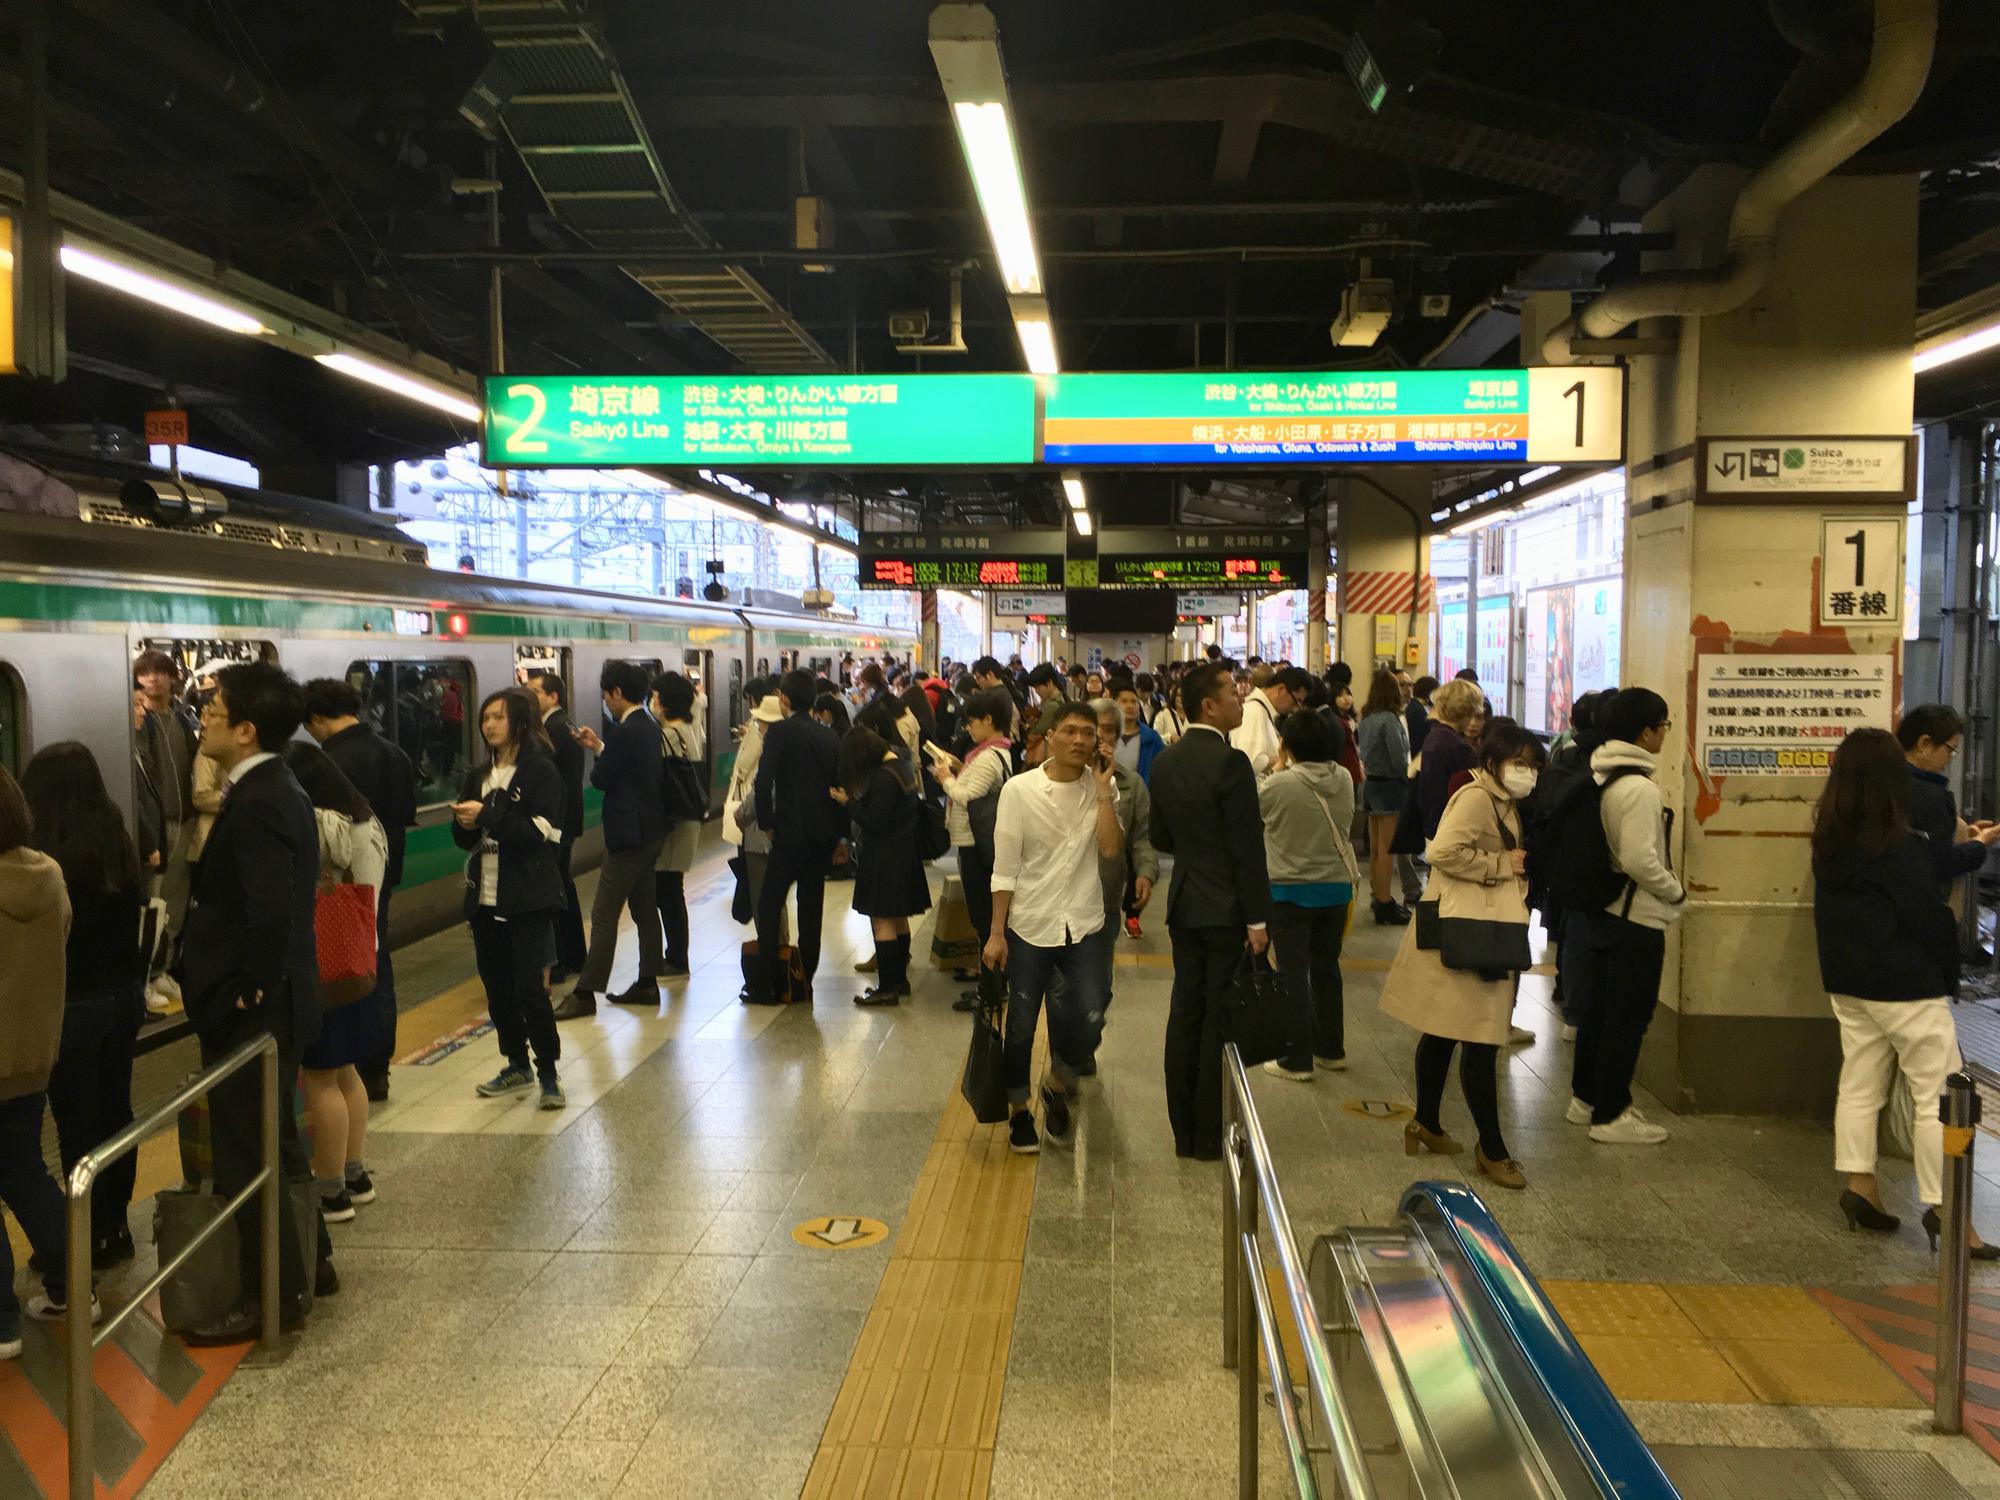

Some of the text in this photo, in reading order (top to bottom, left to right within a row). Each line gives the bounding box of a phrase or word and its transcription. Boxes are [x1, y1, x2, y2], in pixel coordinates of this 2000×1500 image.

[569, 385, 661, 416] 埼京線
[1377, 400, 1397, 410] Line
[1497, 399, 1518, 409] Line
[825, 405, 849, 416] Line
[1563, 381, 1585, 447] 1
[506, 384, 548, 453] 2
[632, 421, 670, 439] Line
[1360, 442, 1368, 452] &
[1495, 440, 1517, 450] Line
[1810, 447, 1843, 457] Suica
[1845, 530, 1865, 586] 1
[1830, 591, 1887, 616] 番線
